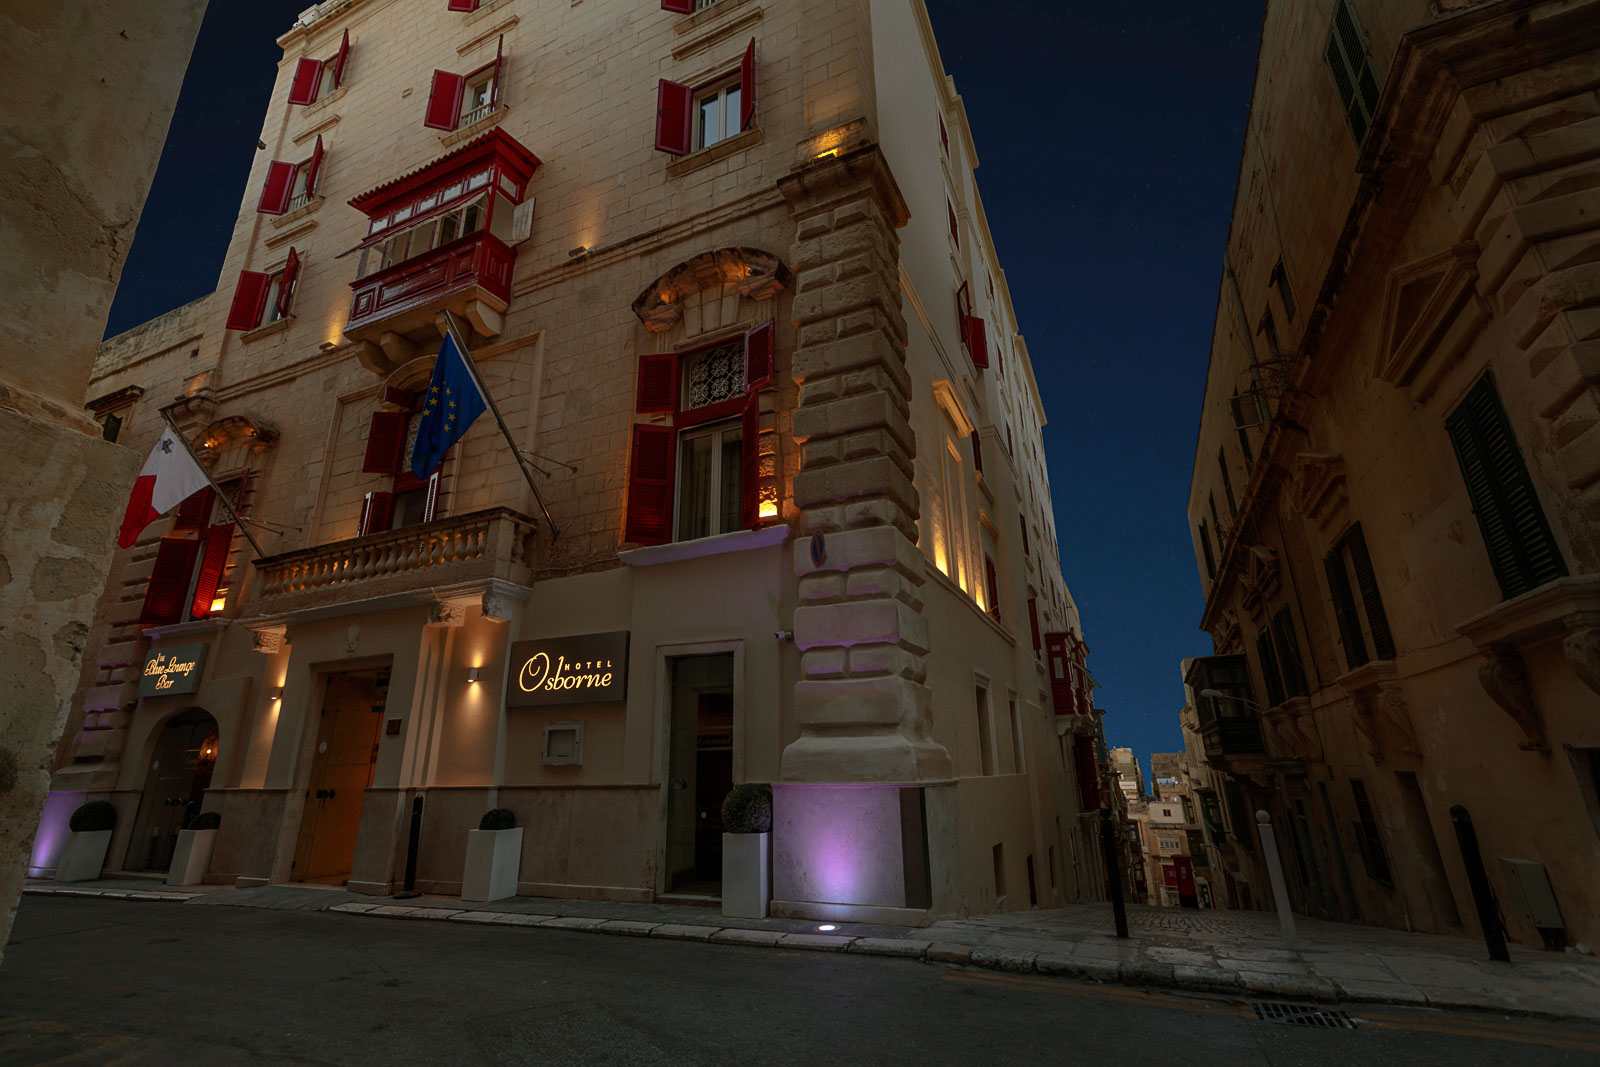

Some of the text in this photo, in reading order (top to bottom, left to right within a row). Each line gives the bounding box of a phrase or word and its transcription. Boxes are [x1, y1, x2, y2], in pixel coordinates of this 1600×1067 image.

[164, 656, 196, 677] Lounge
[519, 652, 612, 692] Osborne
[564, 660, 612, 671] HOTEL
[155, 674, 175, 690] Bar
